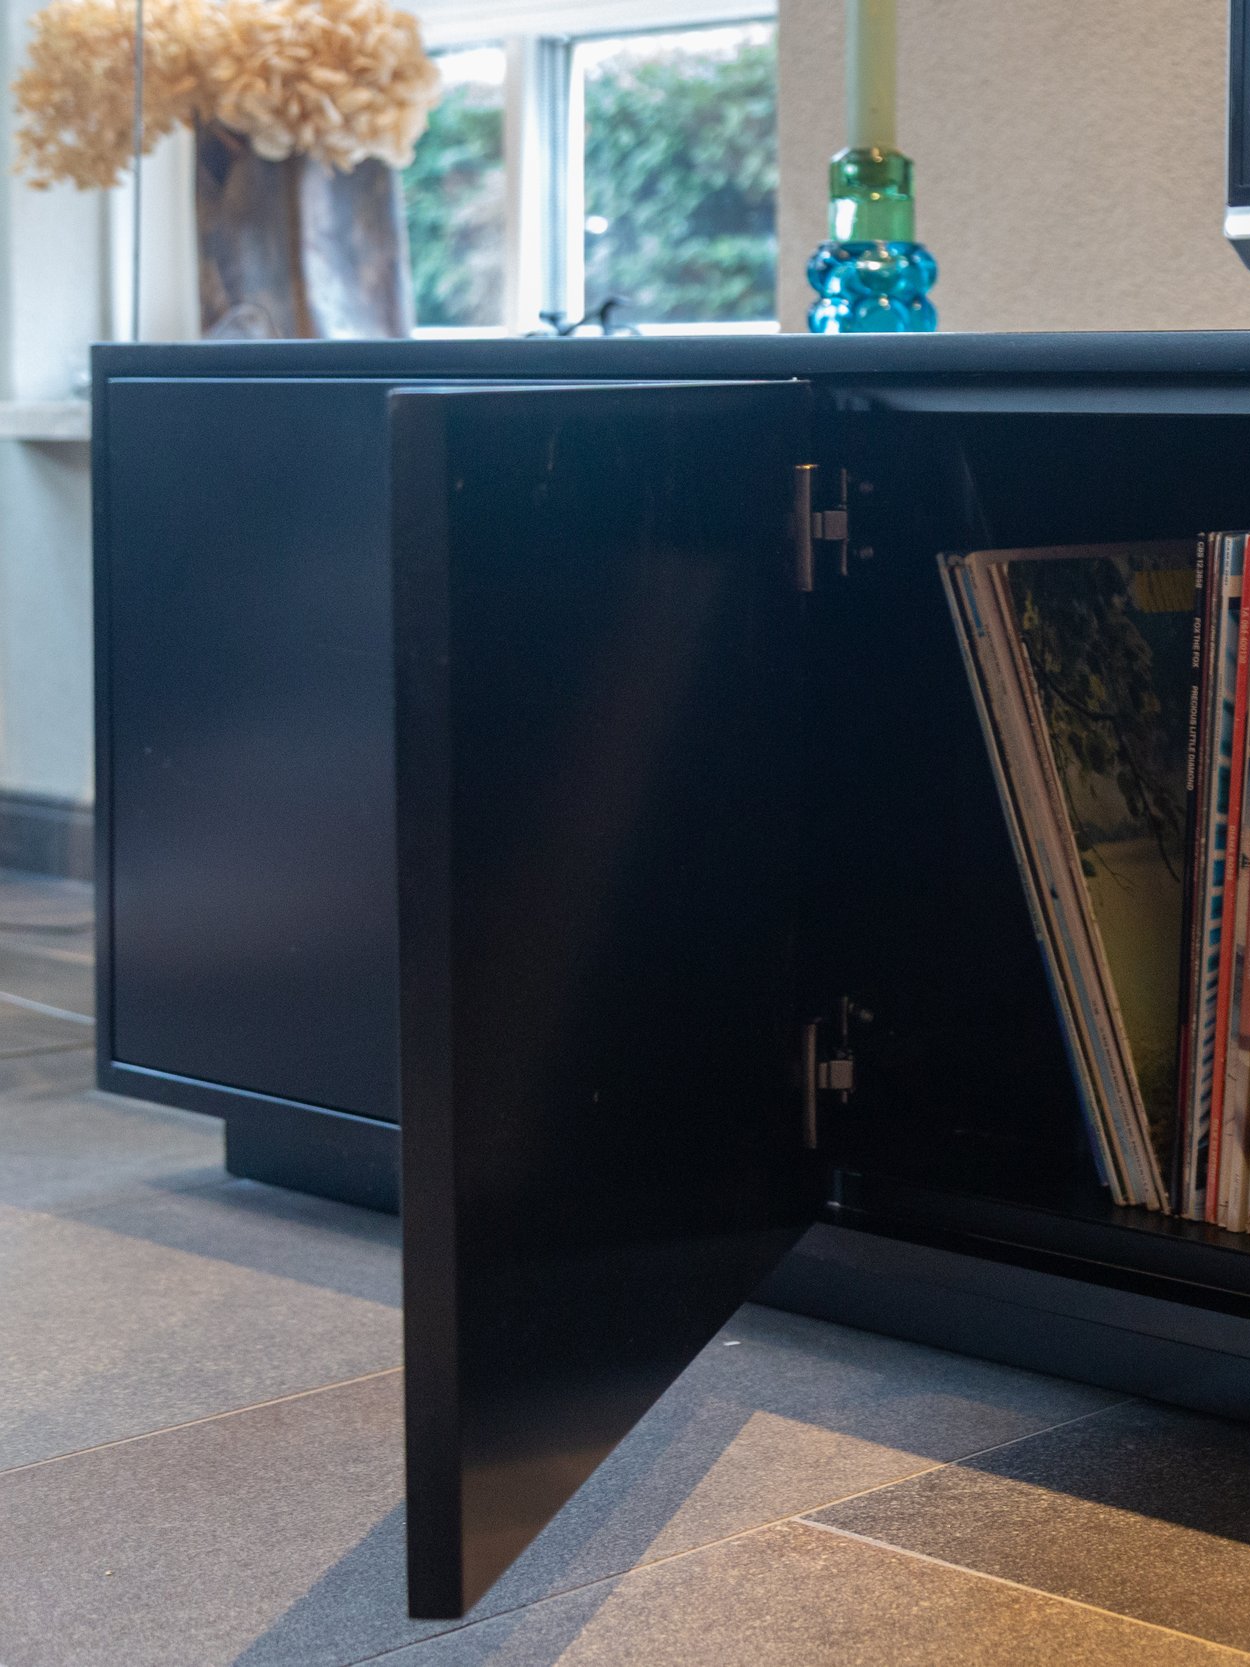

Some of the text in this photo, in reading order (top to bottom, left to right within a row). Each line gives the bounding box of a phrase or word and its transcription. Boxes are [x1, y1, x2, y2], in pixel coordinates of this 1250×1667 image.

[1197, 541, 1205, 557] CBS
[1193, 617, 1202, 632] FOX
[1192, 635, 1201, 650] THE
[1191, 652, 1200, 668] FOX
[1189, 685, 1199, 725] PRECIOUS
[1188, 726, 1197, 752] LITTLE
[1186, 753, 1196, 791] DIAMOND
[1228, 825, 1236, 852] DIANA
[1226, 856, 1234, 881] ROSS
